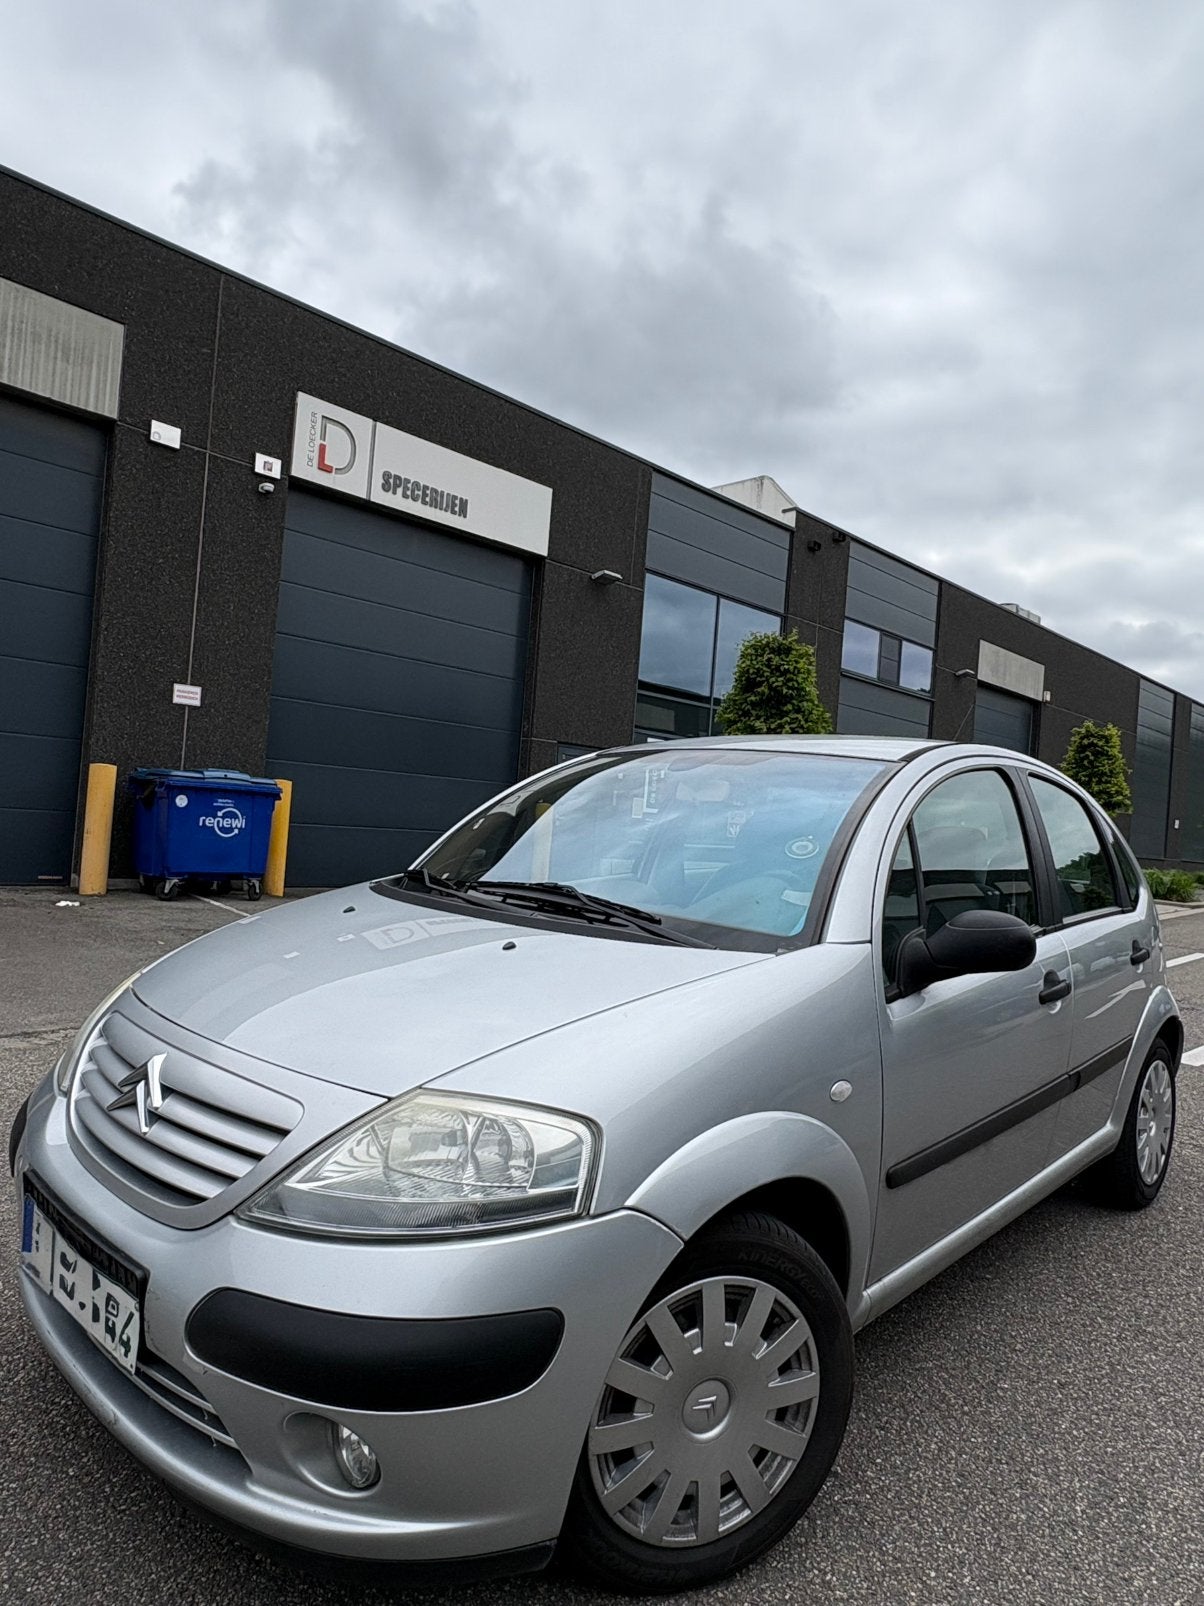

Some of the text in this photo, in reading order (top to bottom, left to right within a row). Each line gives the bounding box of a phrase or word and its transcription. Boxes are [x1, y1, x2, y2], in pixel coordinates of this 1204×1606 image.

[306, 411, 318, 468] DE LOECKER
[381, 470, 469, 519] SPECERIJEN
[199, 814, 246, 831] renewi
